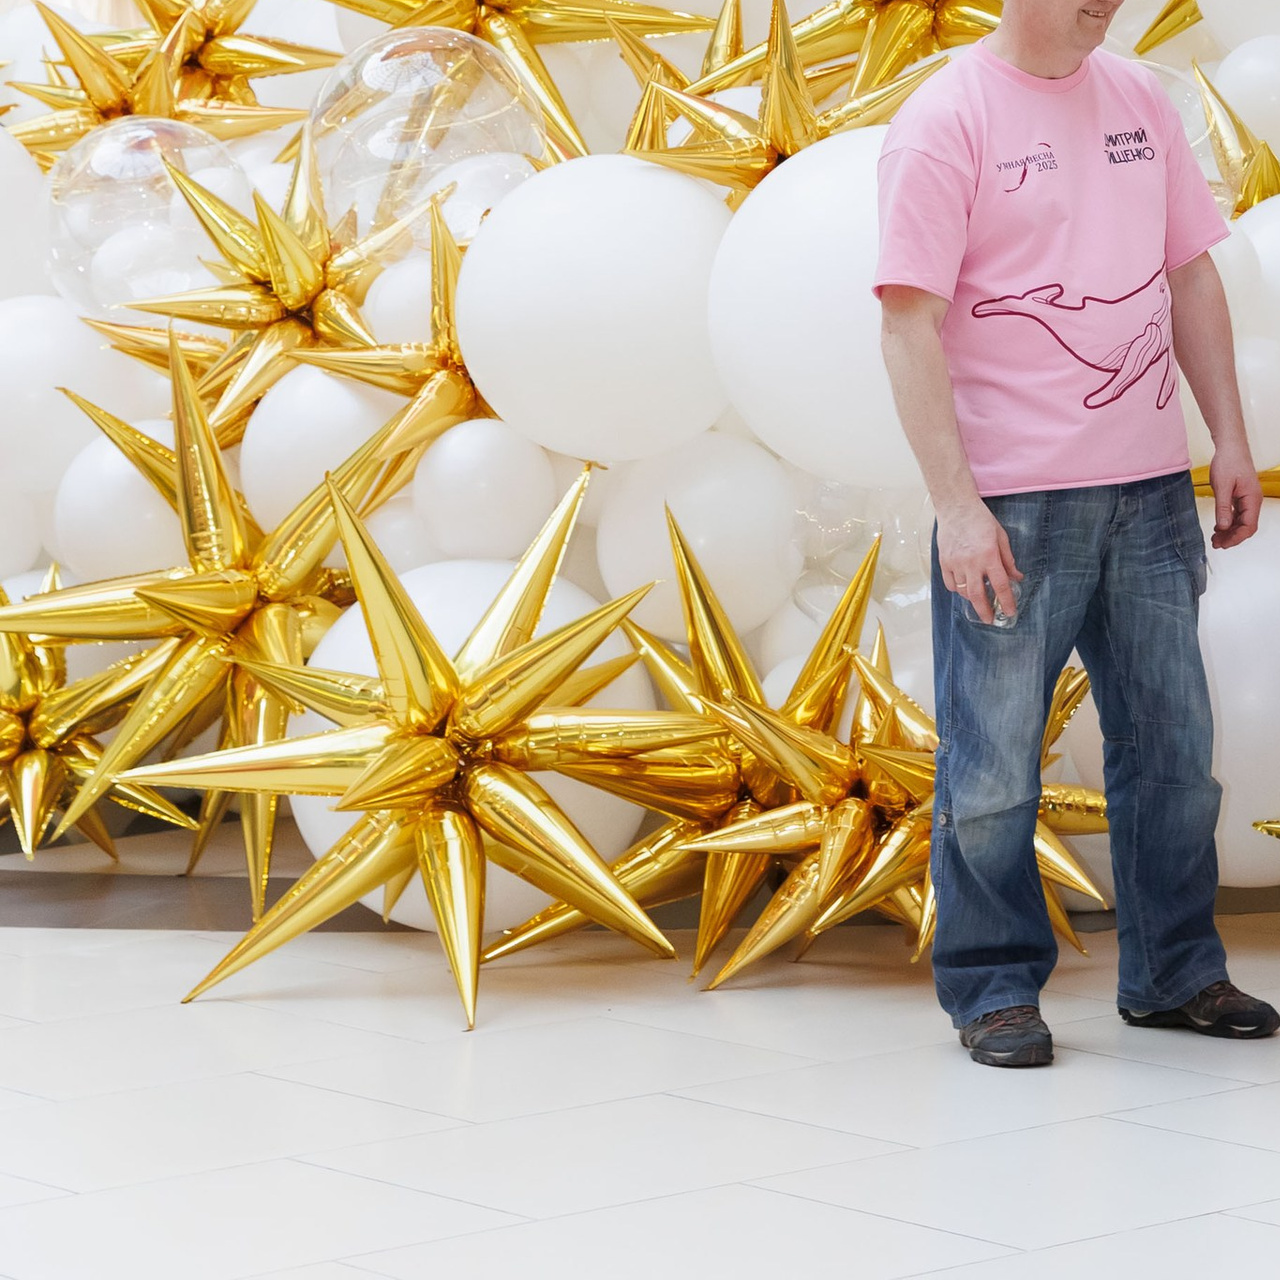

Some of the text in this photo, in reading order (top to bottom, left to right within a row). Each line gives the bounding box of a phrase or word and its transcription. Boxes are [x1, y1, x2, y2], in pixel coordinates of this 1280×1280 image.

[996, 151, 1055, 173] УМНАЯ ВЕСНА
[1035, 159, 1059, 172] 2025
